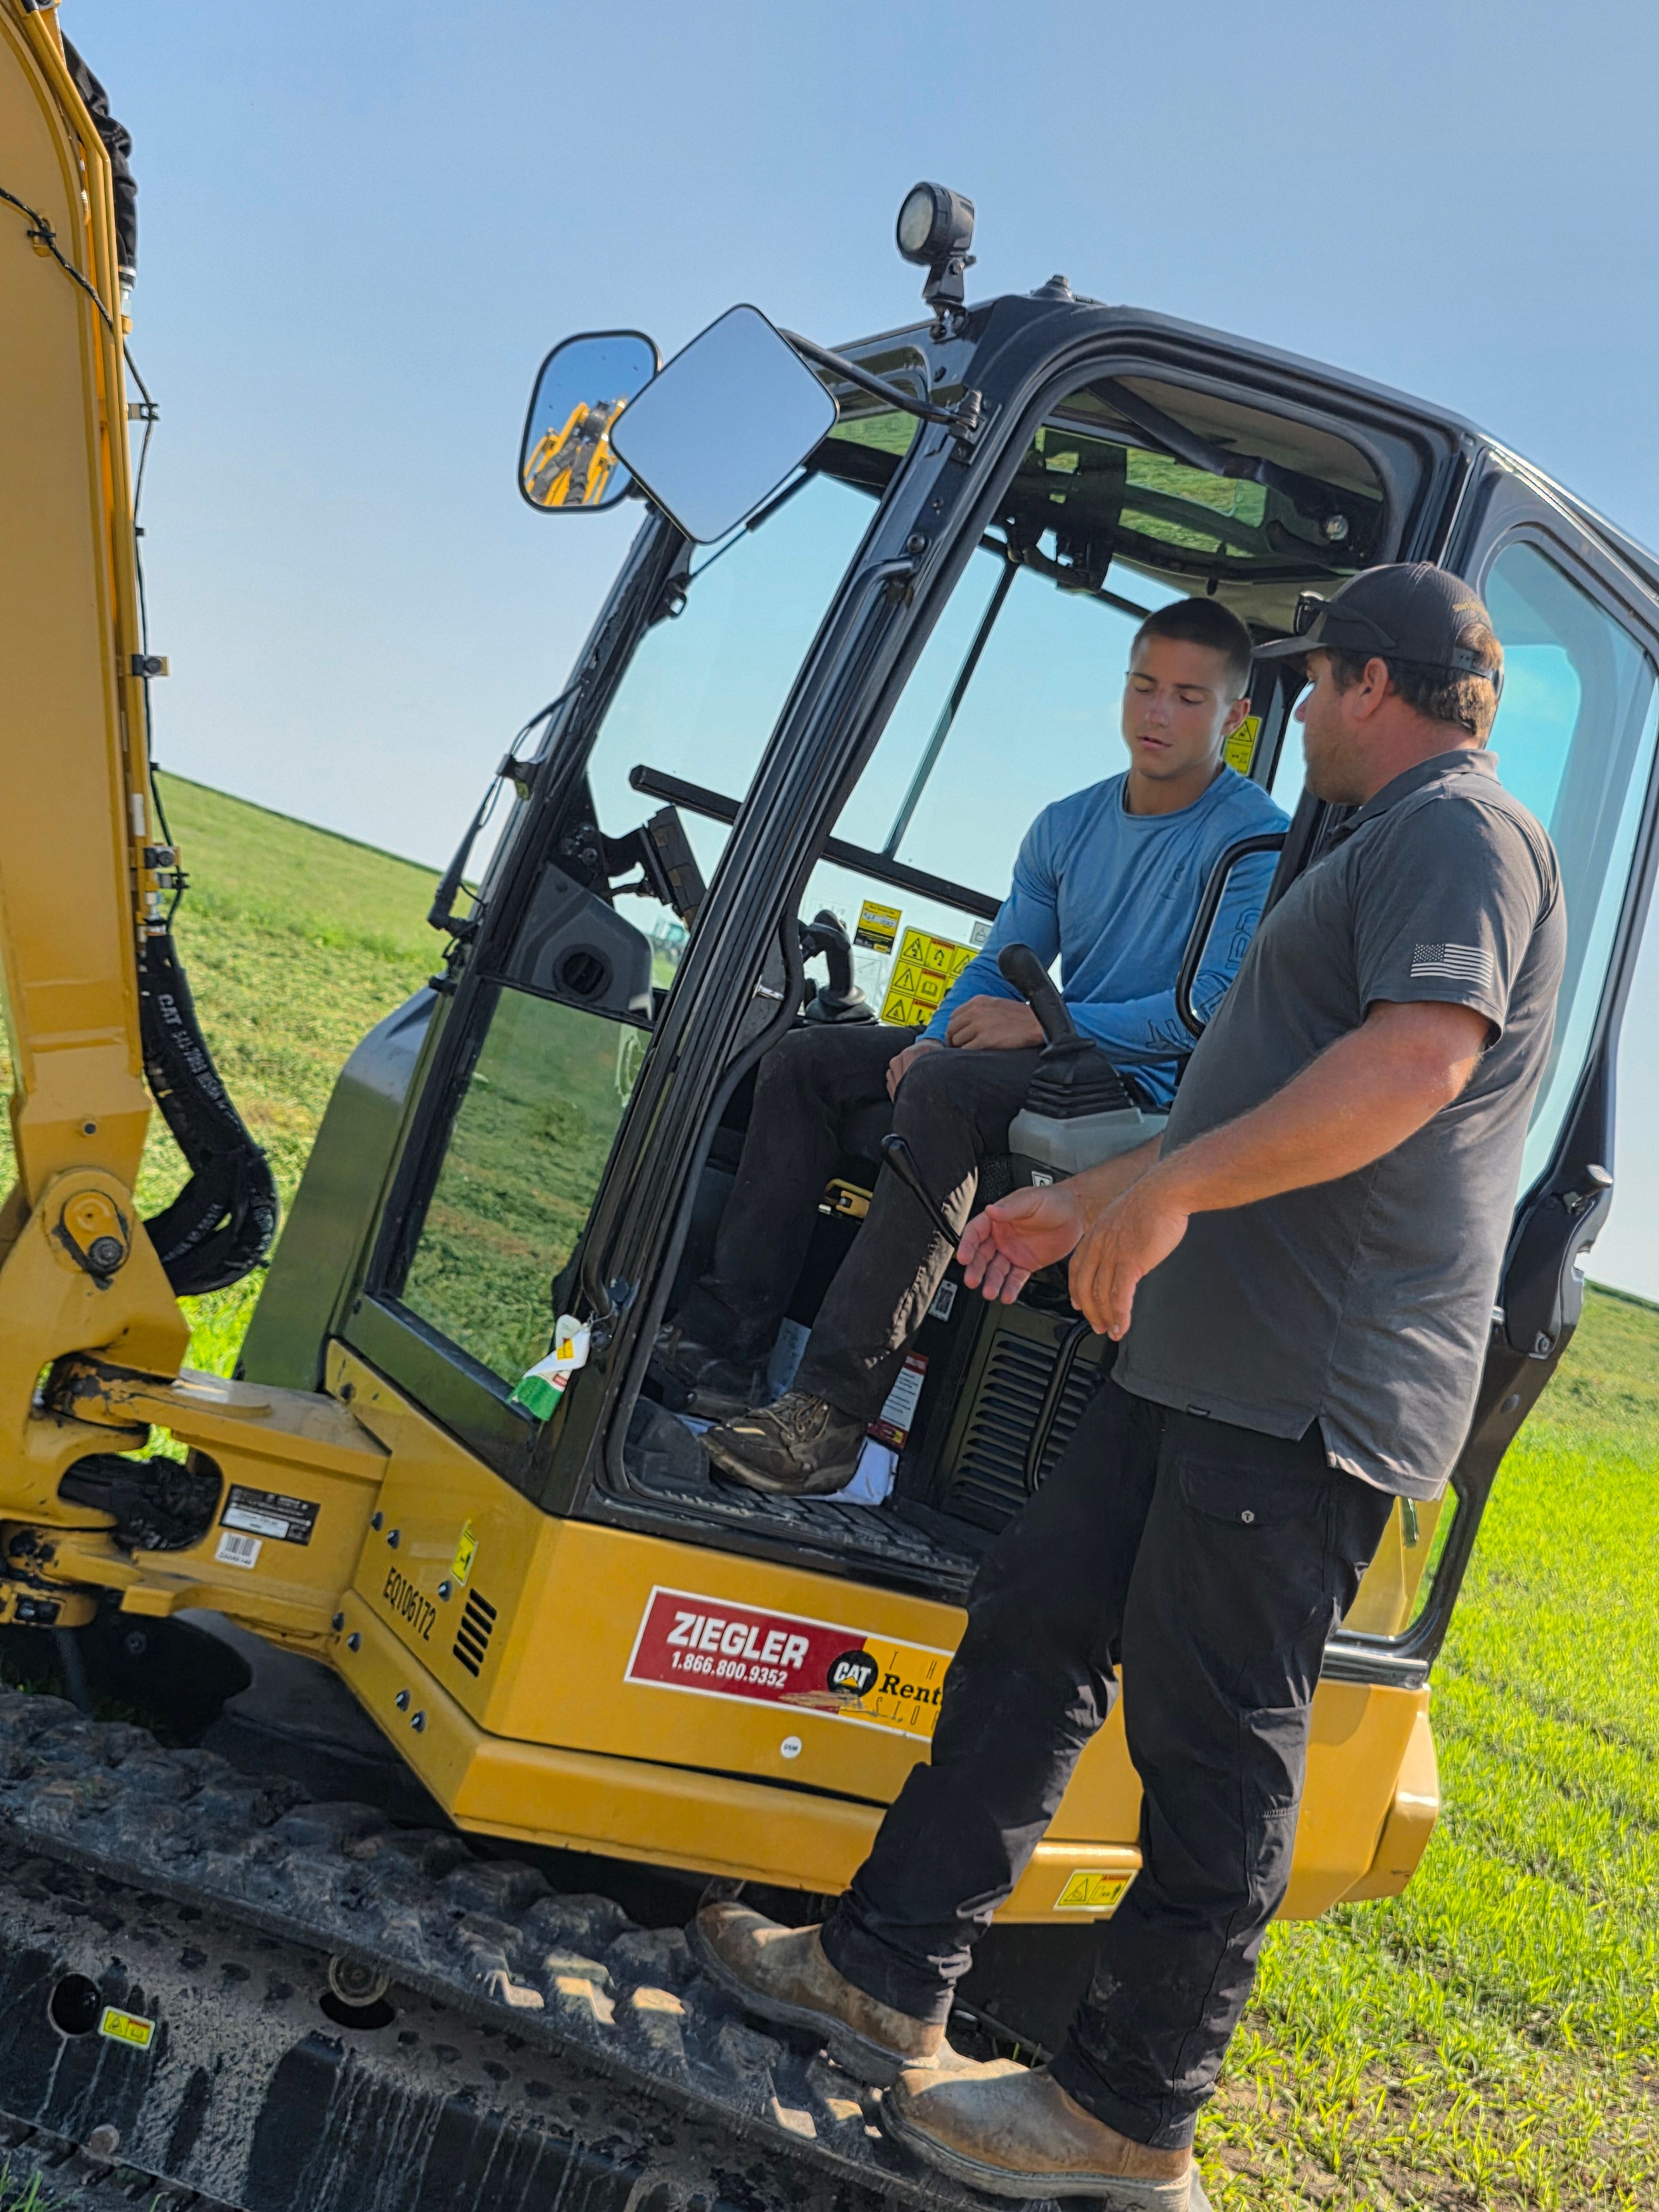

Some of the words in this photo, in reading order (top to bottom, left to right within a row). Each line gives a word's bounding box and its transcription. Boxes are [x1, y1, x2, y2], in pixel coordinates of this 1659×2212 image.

[158, 994, 182, 1025] CAT
[666, 1611, 810, 1670] ZIEGLER
[671, 1651, 787, 1688] 1.866.800.9352
[833, 1661, 872, 1690] CAT
[889, 1651, 937, 1680] TH
[878, 1673, 942, 1705] Rent
